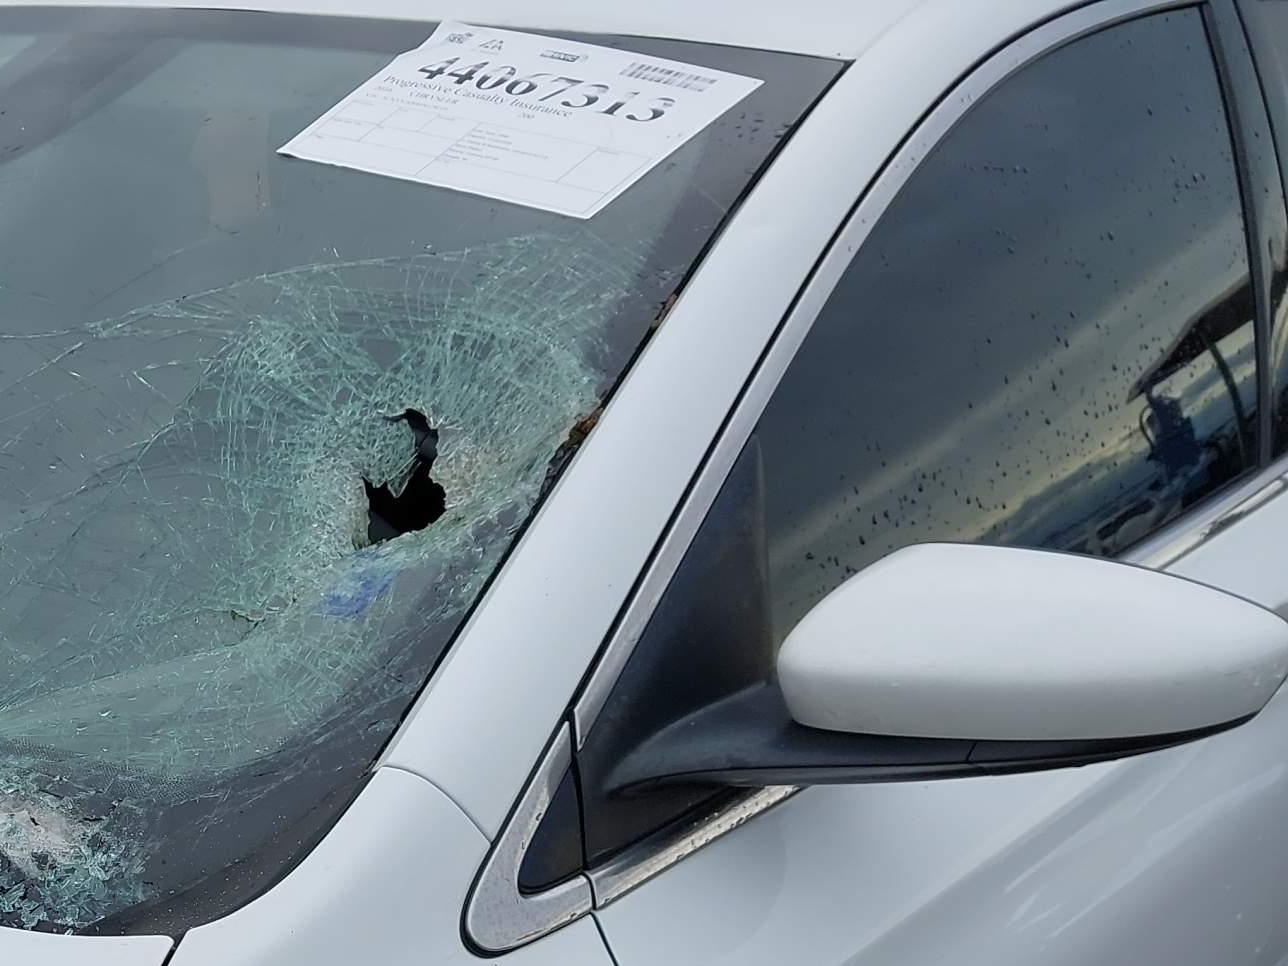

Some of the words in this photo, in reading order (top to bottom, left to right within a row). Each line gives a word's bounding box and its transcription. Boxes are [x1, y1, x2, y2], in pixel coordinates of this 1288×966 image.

[383, 75, 452, 94] Progressive
[454, 88, 506, 105] Casualty
[509, 98, 573, 118] Insurance
[418, 56, 676, 122] 44067313
